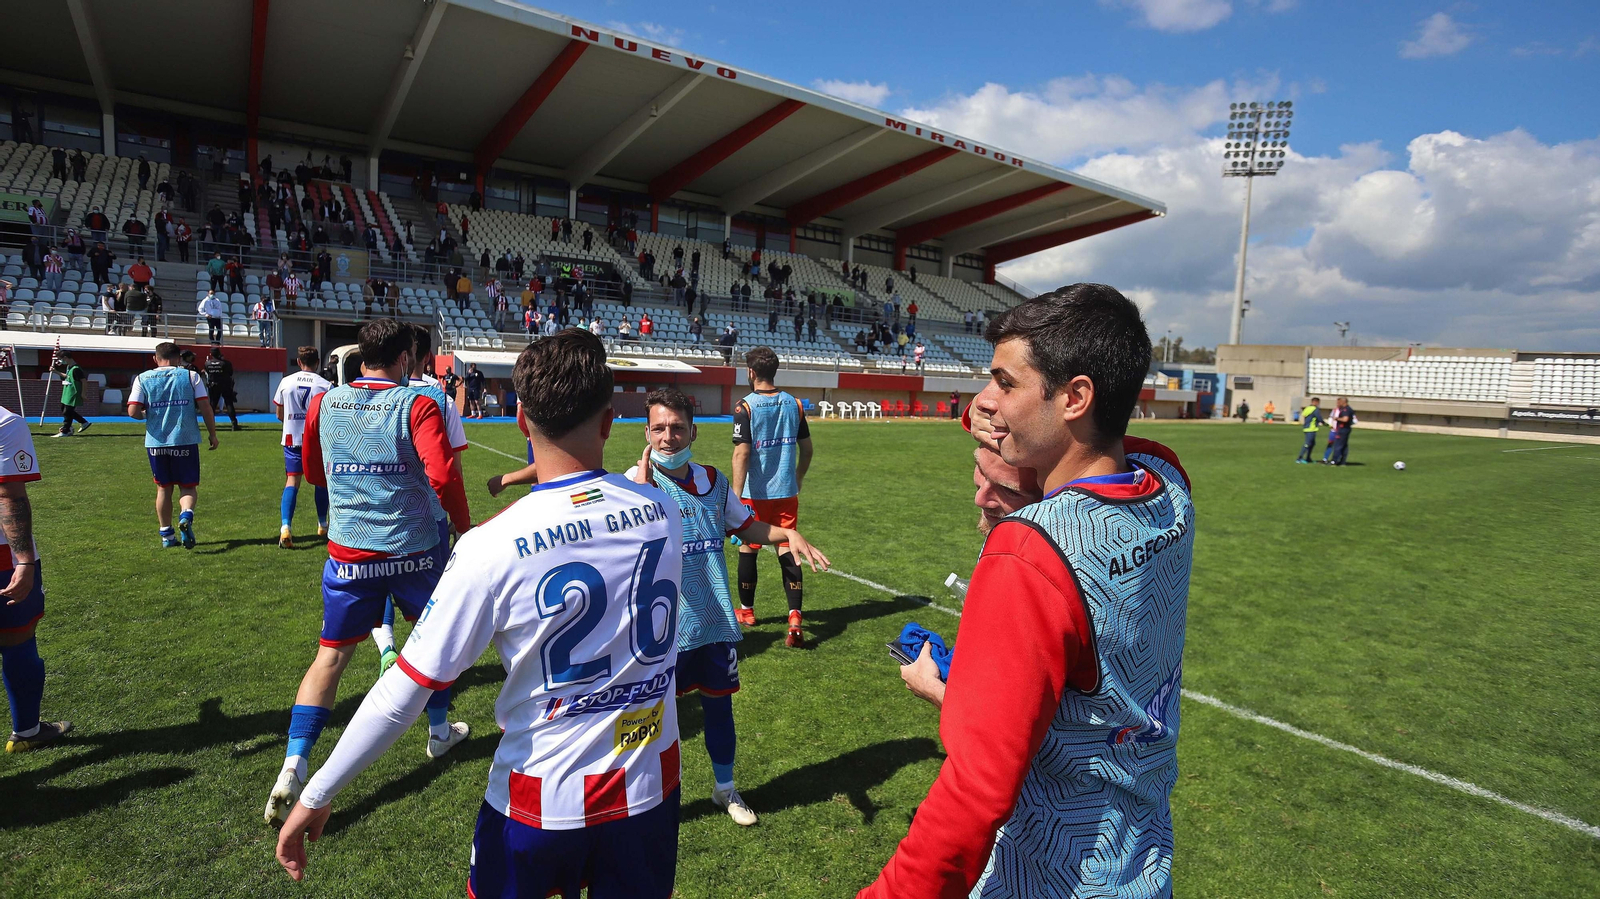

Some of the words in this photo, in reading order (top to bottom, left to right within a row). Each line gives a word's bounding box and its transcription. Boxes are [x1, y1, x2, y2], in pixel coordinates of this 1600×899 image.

[571, 25, 737, 80] NUEVO
[885, 117, 1024, 167] MIRADOR
[298, 386, 311, 410] 7
[330, 401, 382, 411] ALGECIRAS
[334, 463, 406, 473] STOP-FLUID
[513, 518, 593, 559] RAMON
[604, 501, 669, 534] GARCIA
[336, 556, 434, 580] ALMINUTO.ES
[535, 536, 678, 692] 26
